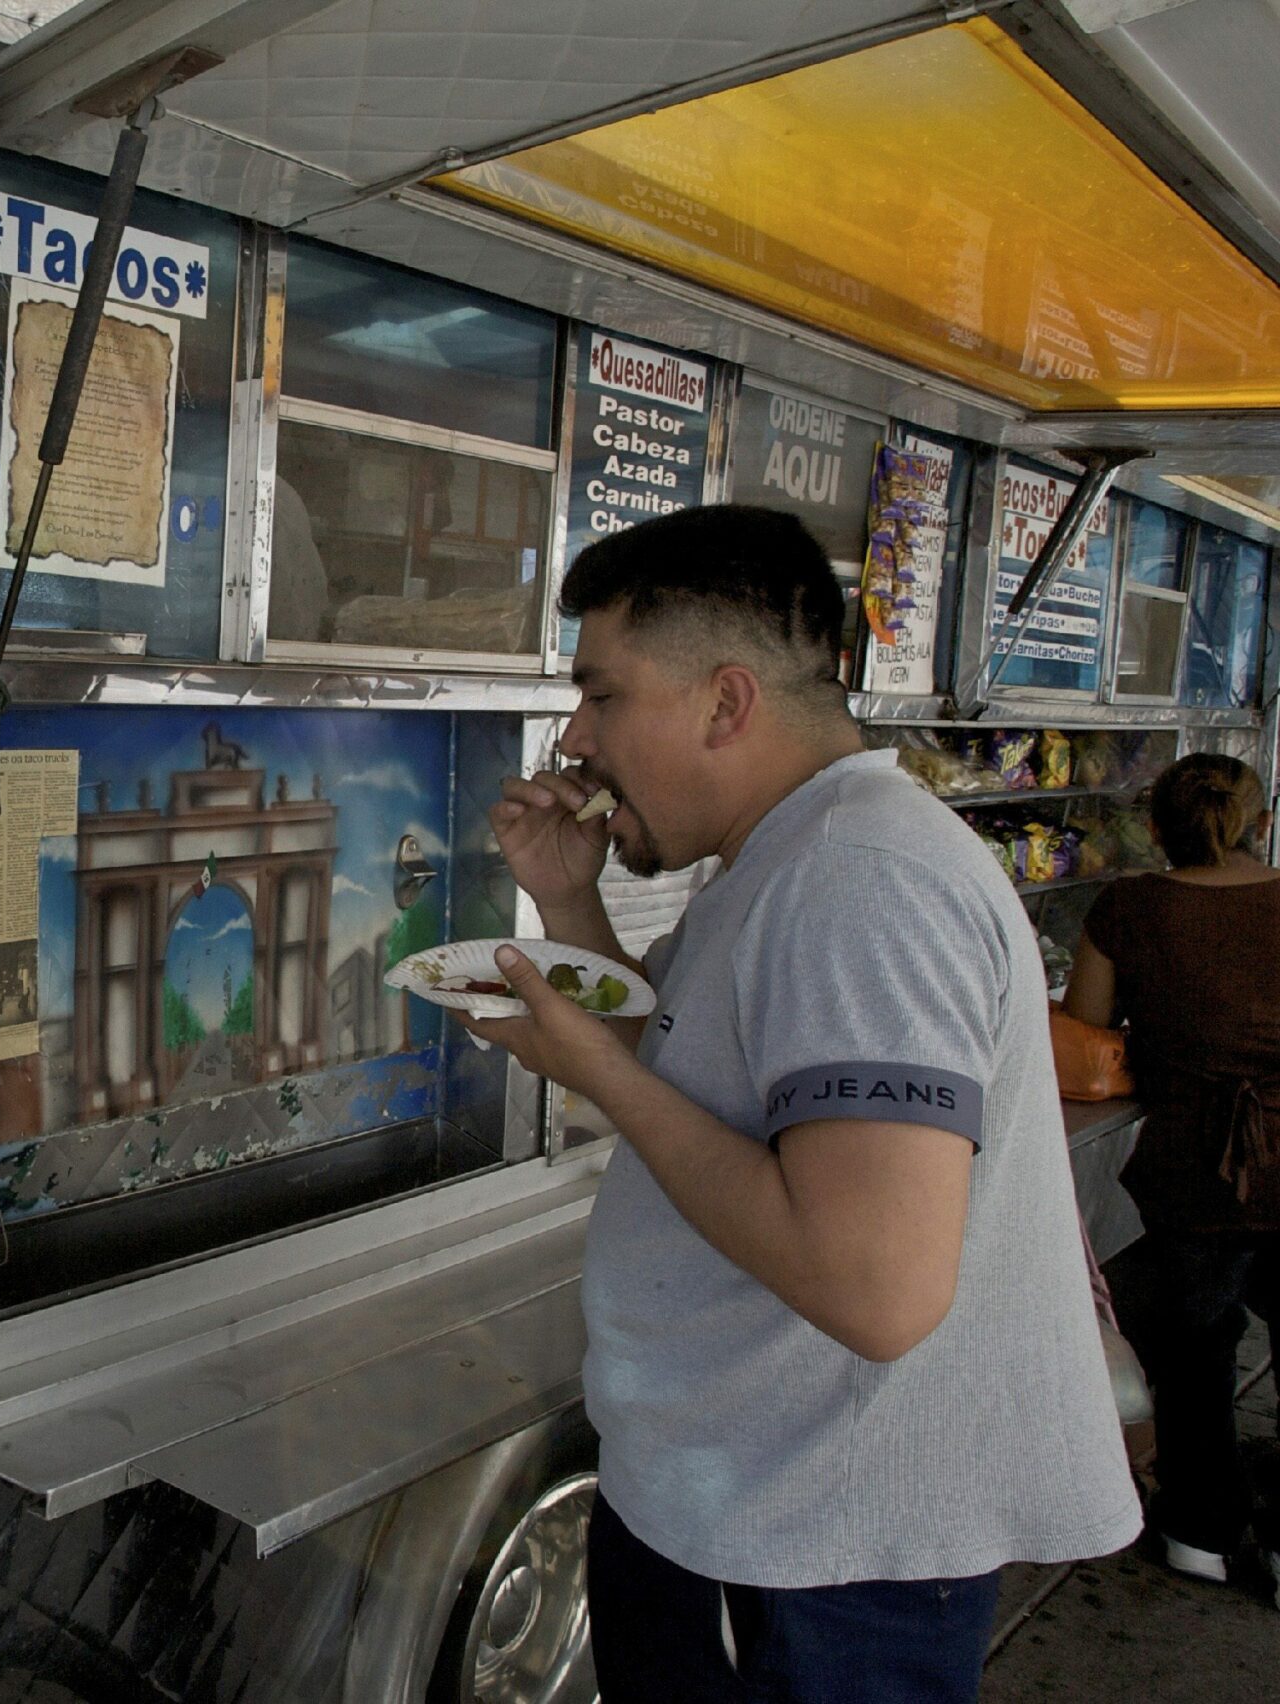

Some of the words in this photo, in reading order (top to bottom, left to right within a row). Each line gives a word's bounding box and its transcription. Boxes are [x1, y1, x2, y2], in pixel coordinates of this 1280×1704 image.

[7, 197, 181, 309] Taos
[600, 339, 696, 405] Quesadillas
[599, 395, 685, 436] Pastor
[770, 395, 846, 448] ORDENE
[593, 424, 690, 465] Cabeza
[603, 455, 677, 488] Azada
[763, 440, 841, 505] AQUI
[586, 480, 686, 515] Carnitas
[1068, 587, 1100, 604] Buche
[1027, 612, 1060, 629] ripas
[1013, 643, 1054, 659] arnitas
[1059, 646, 1094, 662] Chorizo
[11, 755, 22, 764] on
[24, 754, 44, 764] taco
[45, 752, 70, 763] trucks
[999, 738, 1035, 775] Tak
[812, 1078, 956, 1111] JEANS
